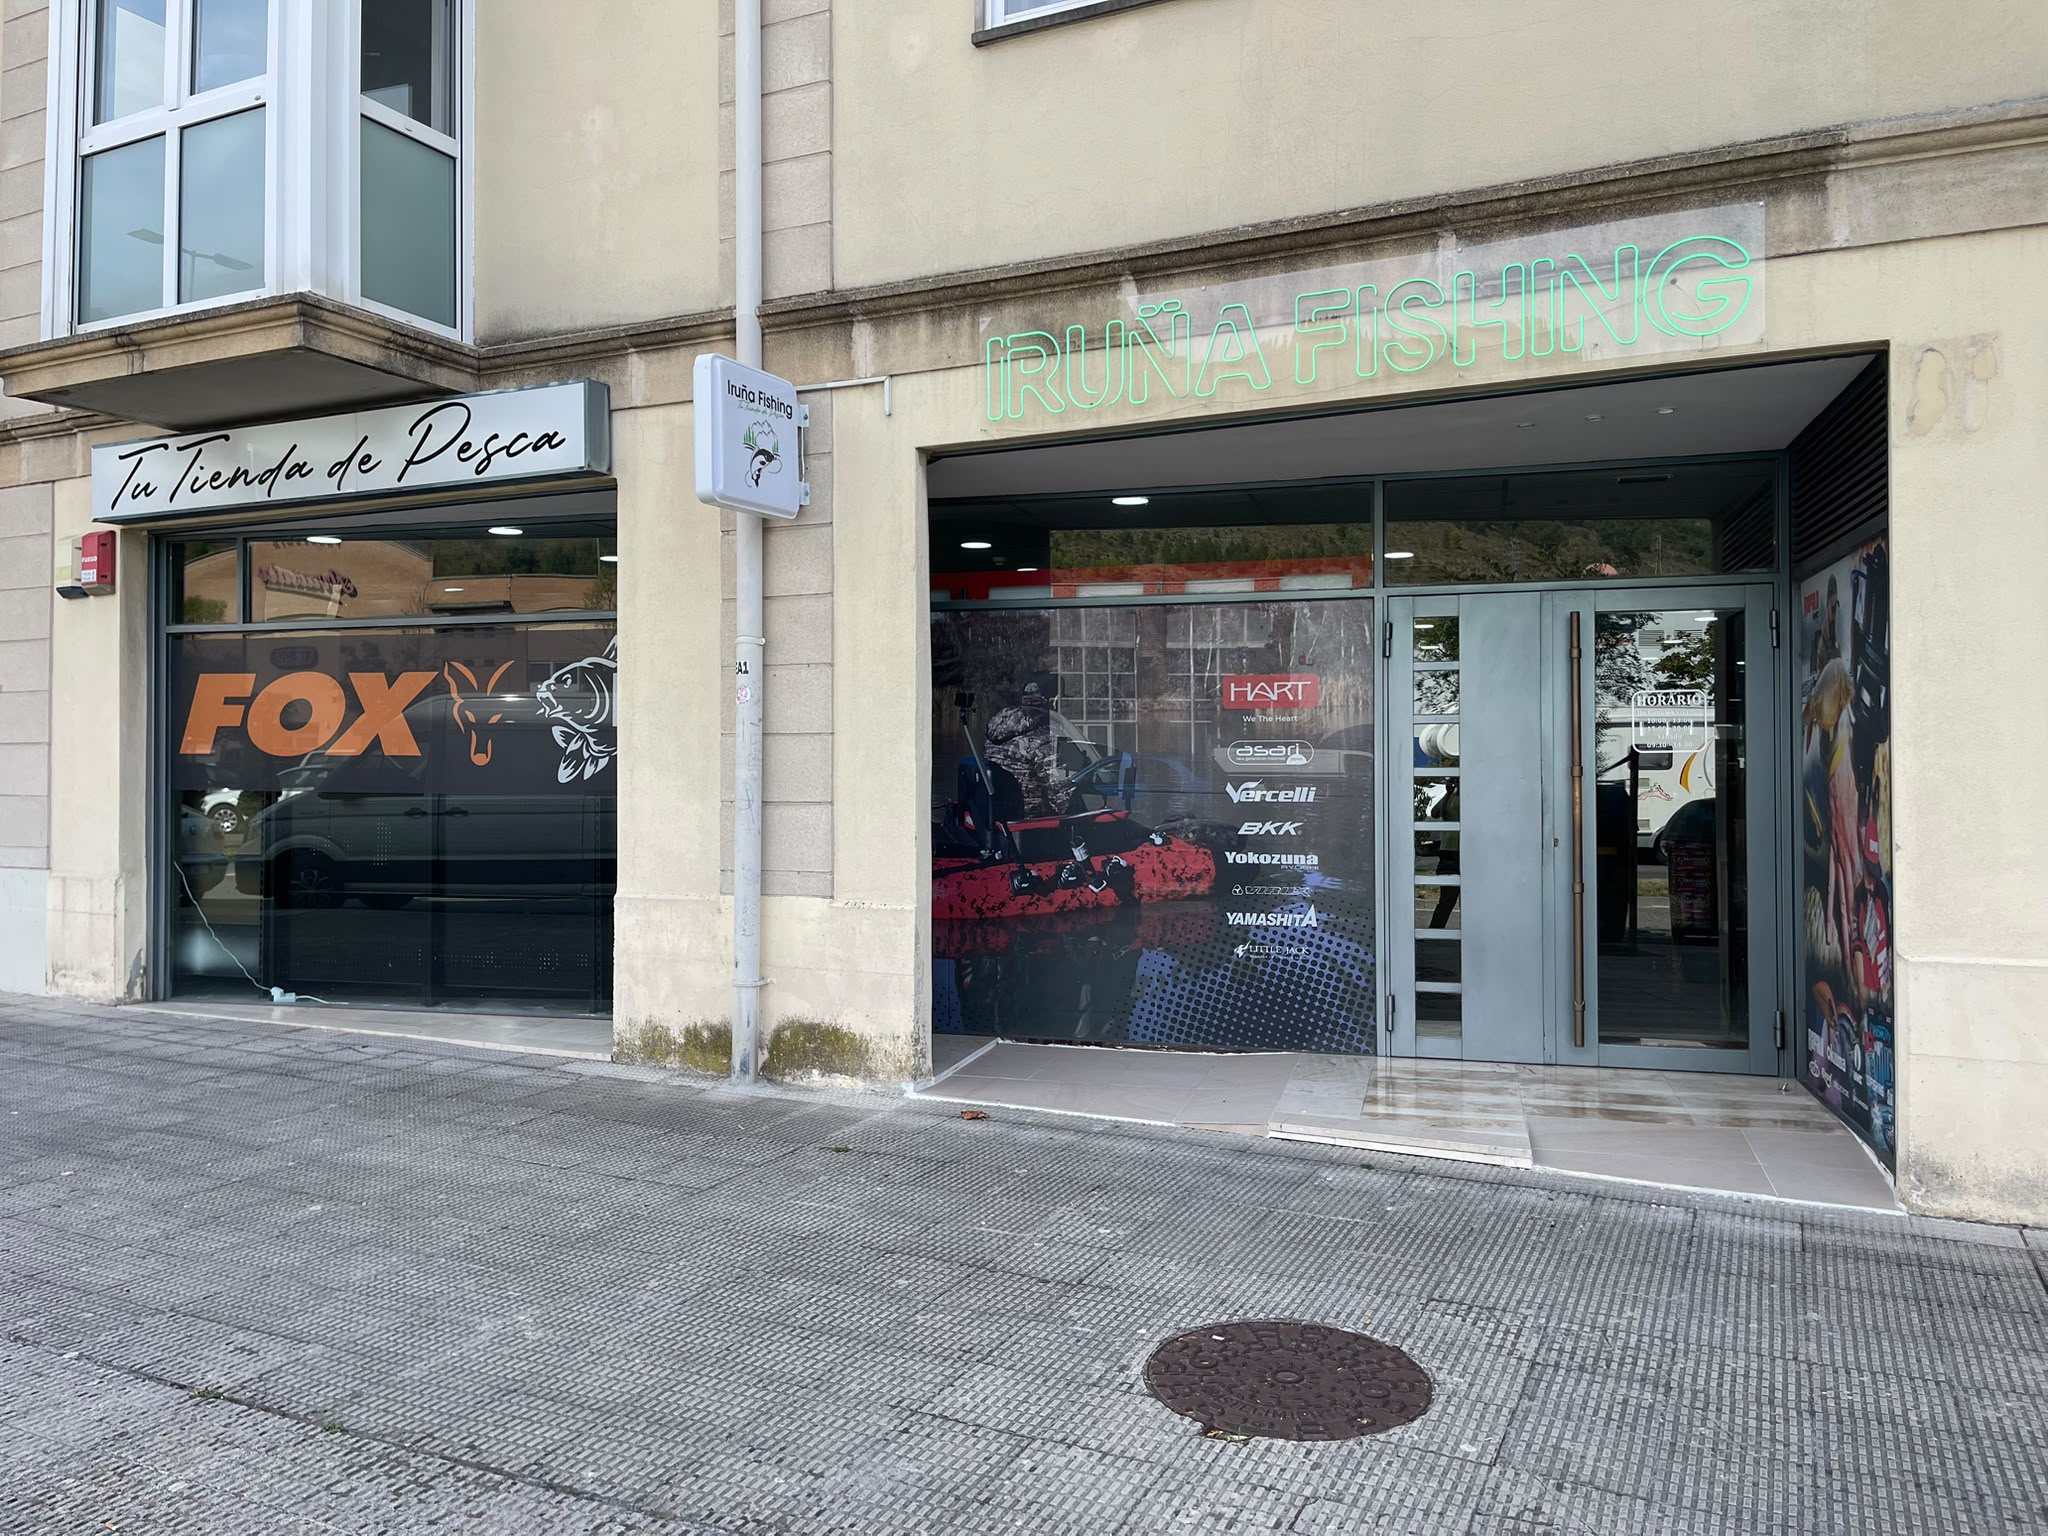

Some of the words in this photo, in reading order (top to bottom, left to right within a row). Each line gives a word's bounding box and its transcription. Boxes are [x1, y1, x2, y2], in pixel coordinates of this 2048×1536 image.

[1295, 235, 1753, 384] FISHING
[727, 379, 755, 403] Iruña
[758, 390, 793, 420] Fishing
[112, 443, 168, 511] Tu
[169, 434, 313, 503] Tienda
[327, 435, 382, 491] de
[397, 401, 566, 482] Pesca
[1230, 681, 1311, 701] HART
[1637, 694, 1701, 706] HORARIO
[179, 671, 439, 757] FOX
[1236, 743, 1299, 757] asari
[1225, 778, 1317, 804] Vercelli
[1237, 820, 1304, 835] BKK
[1224, 851, 1319, 865] Yokozuna
[1226, 904, 1318, 927] YAMASHITA
[1249, 945, 1281, 954] LITTLE
[1282, 946, 1309, 956] JACK
